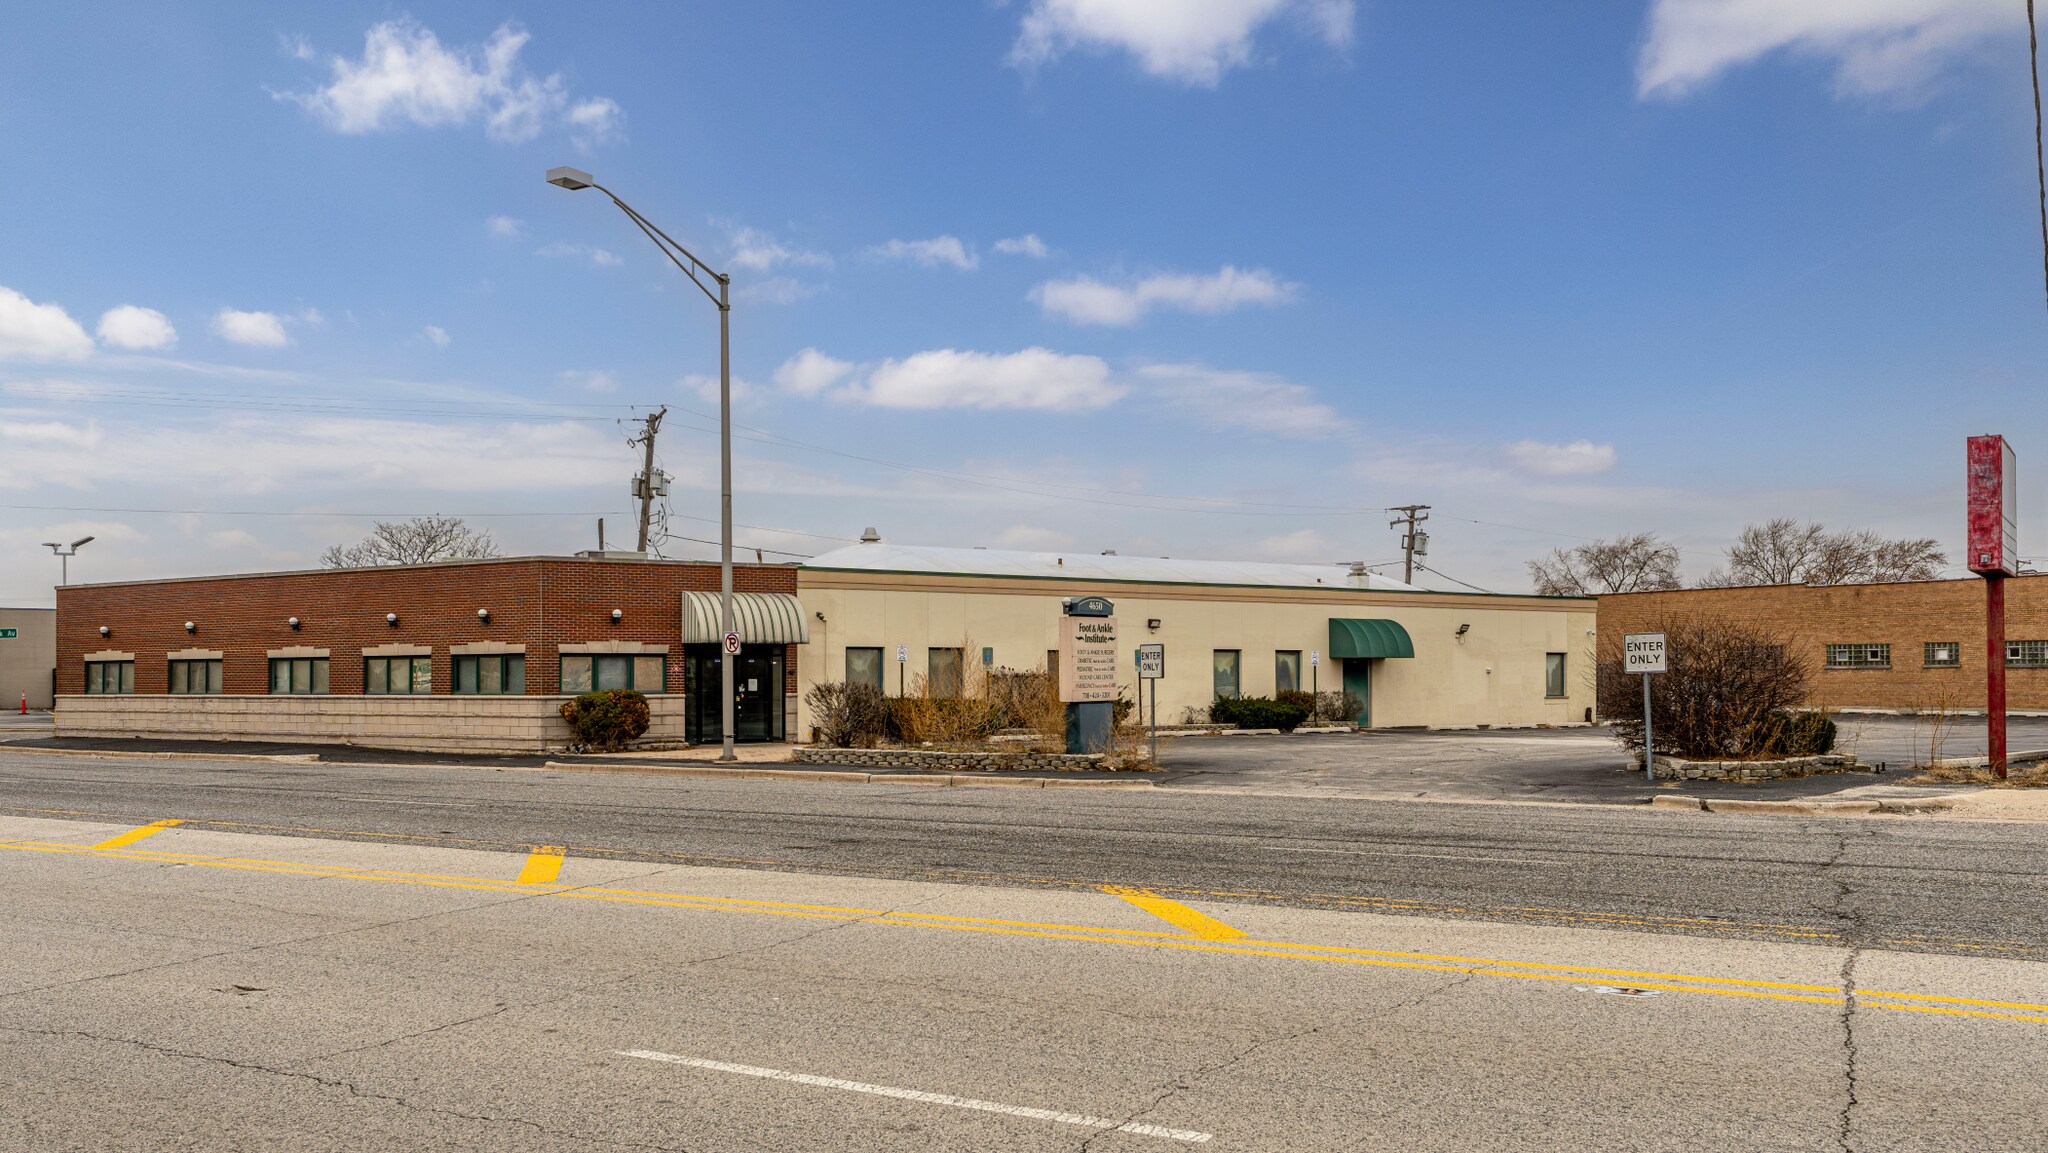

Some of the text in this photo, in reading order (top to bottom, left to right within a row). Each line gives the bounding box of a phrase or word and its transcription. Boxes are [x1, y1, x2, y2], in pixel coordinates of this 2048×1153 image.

[1089, 601, 1103, 610] 4650
[1079, 622, 1113, 633] Foot & Ankle
[1084, 633, 1108, 643] Institute
[1627, 642, 1663, 651] ENTER
[1141, 651, 1161, 660] ENTER
[1630, 654, 1660, 664] ONLY
[1143, 662, 1159, 671] ONLY
